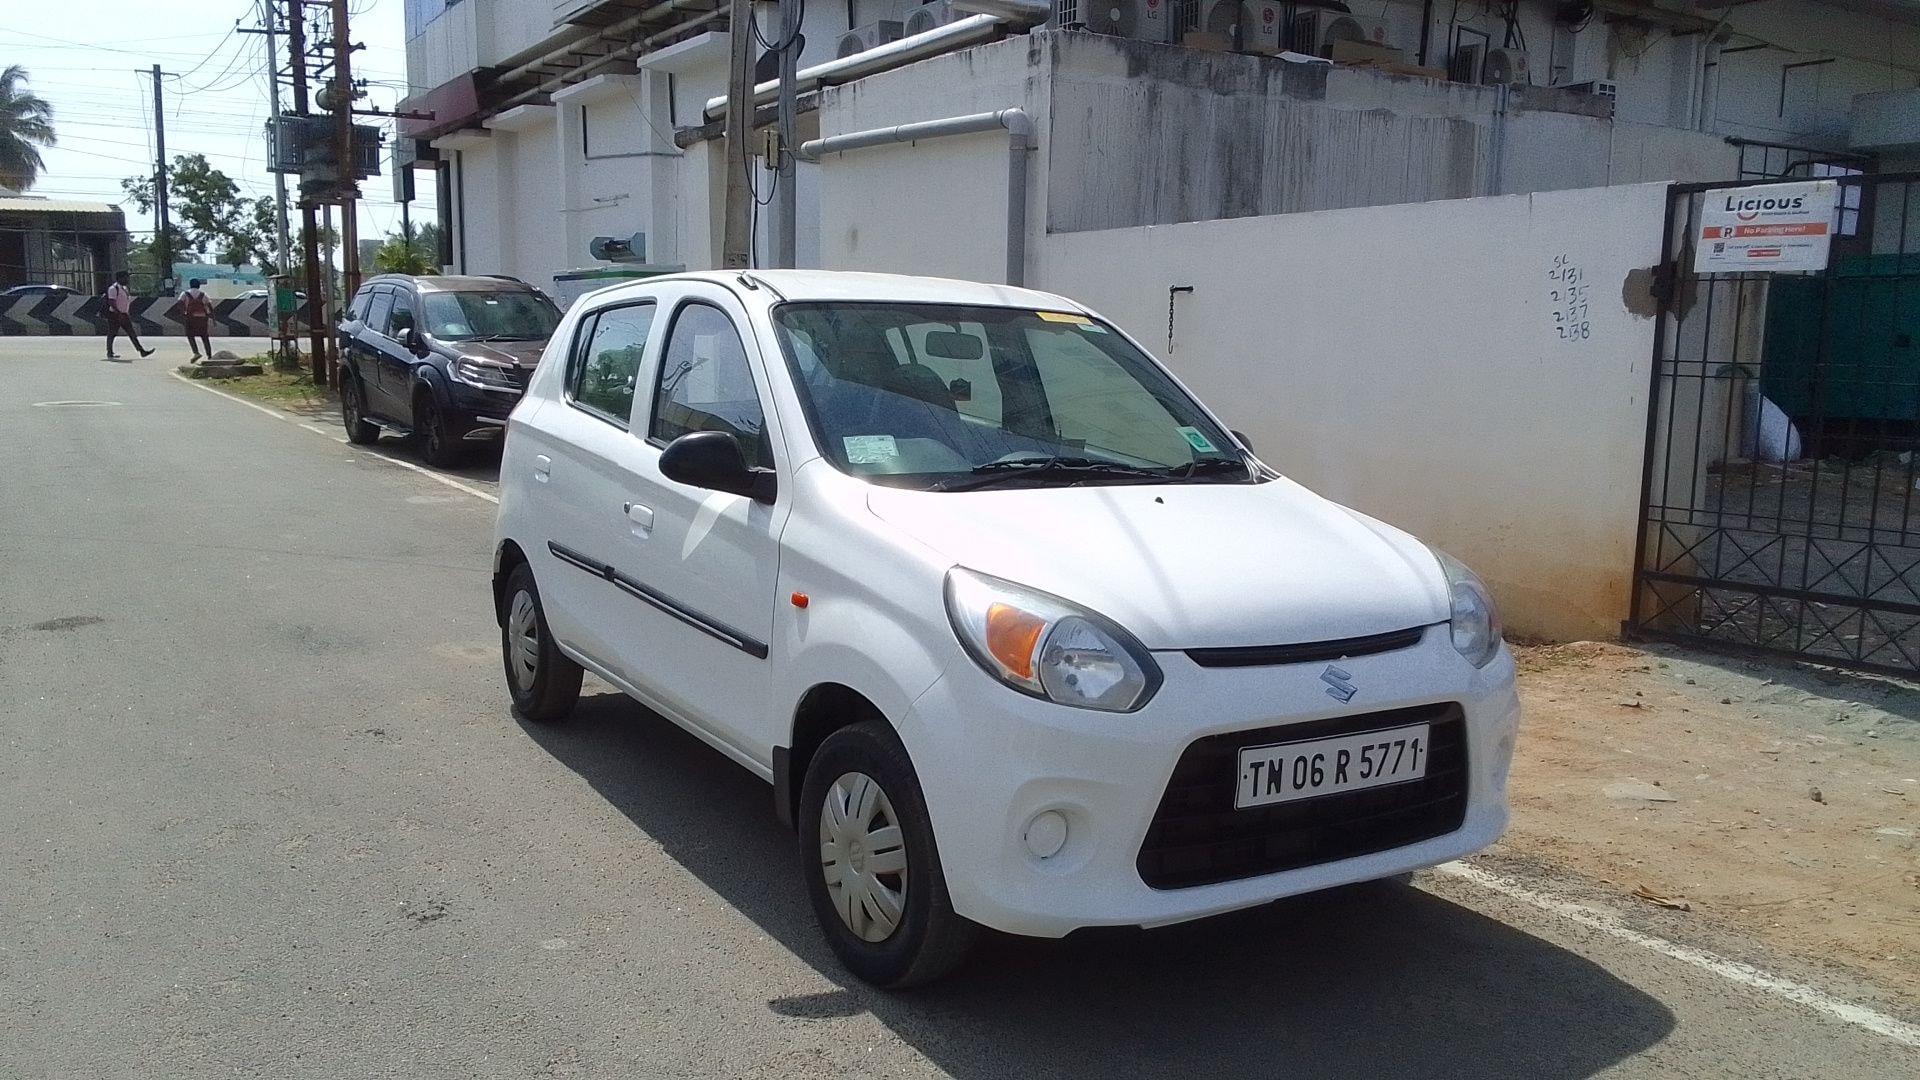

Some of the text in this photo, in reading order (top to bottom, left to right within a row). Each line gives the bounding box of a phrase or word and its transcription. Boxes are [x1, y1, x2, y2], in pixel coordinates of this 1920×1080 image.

[1147, 10, 1158, 20] LG
[1263, 25, 1273, 35] LG
[1725, 194, 1803, 212] Licious
[1743, 227, 1754, 235] No
[1548, 267, 1583, 285] 2131
[1552, 303, 1588, 322] 2137
[1556, 320, 1590, 342] 2138
[1249, 737, 1420, 798] TN 06 R 5771
